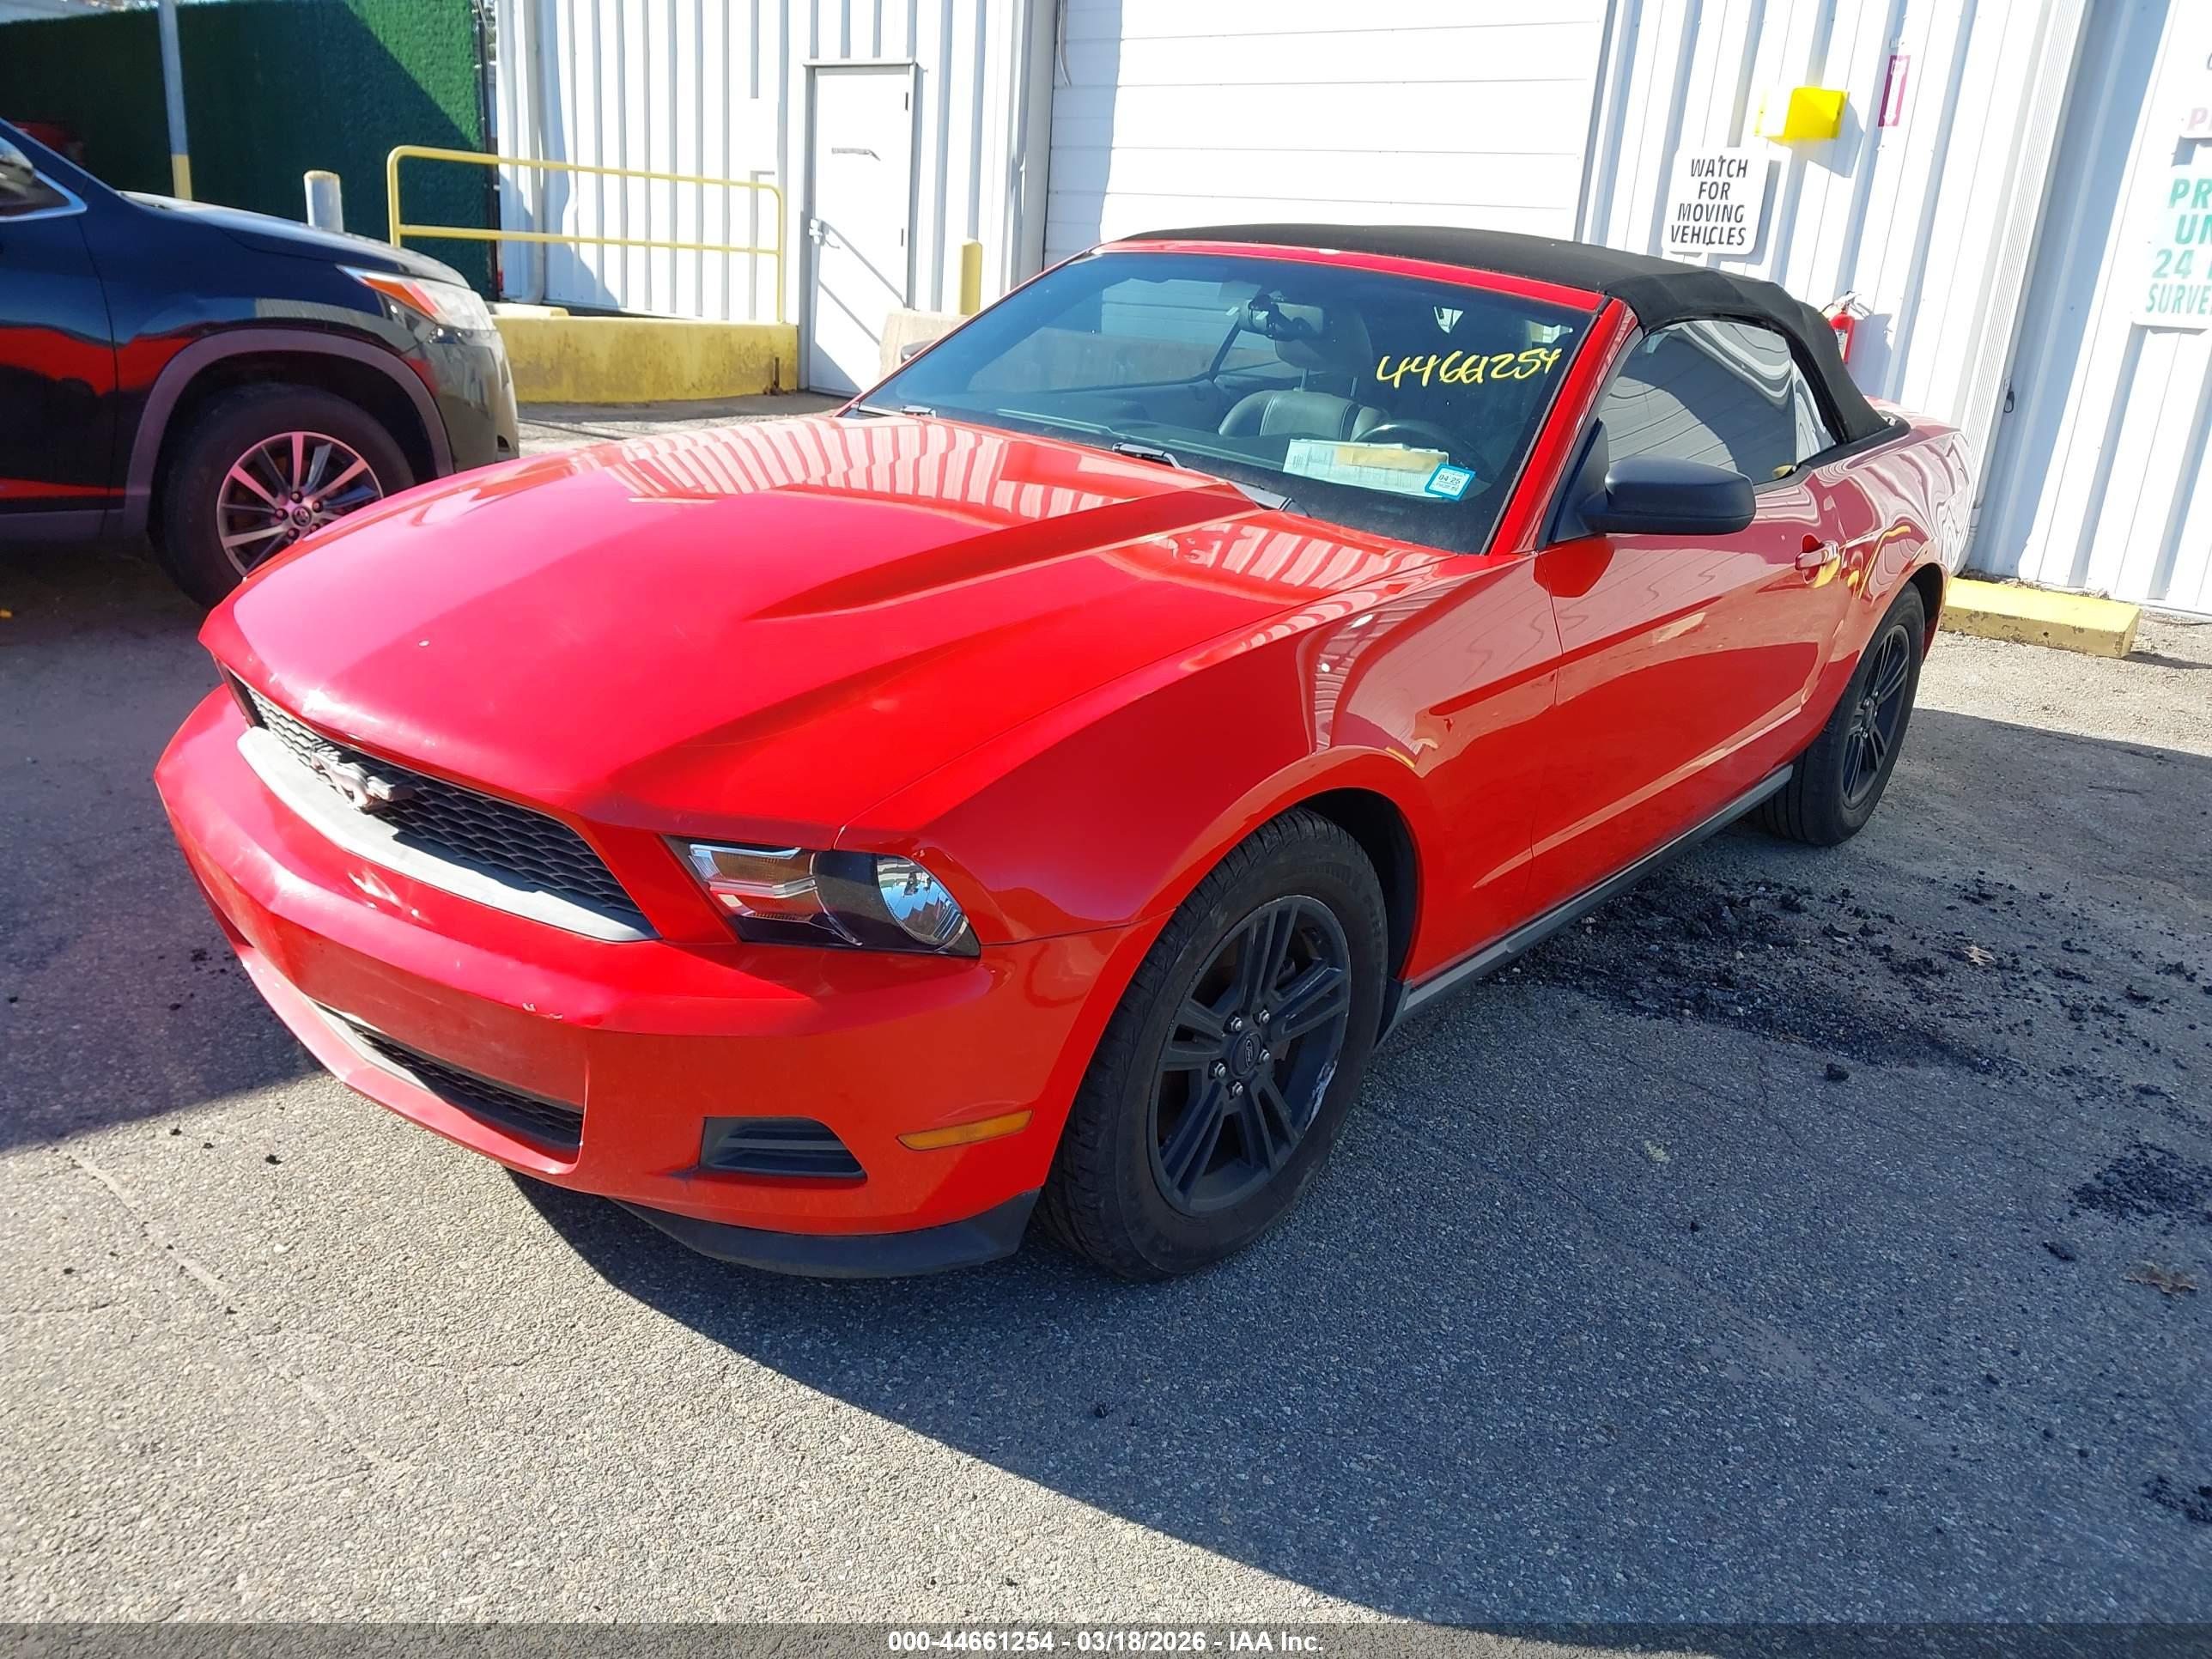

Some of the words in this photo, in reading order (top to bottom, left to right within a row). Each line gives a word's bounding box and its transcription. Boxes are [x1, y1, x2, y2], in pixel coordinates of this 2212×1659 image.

[2186, 107, 2212, 131] P
[1690, 157, 1748, 178] WATCH
[1698, 181, 1731, 200] FOR
[1677, 203, 1745, 223] MOVING
[1670, 225, 1747, 246] VEHICLES
[2152, 249, 2195, 279] 24
[2146, 283, 2212, 314] SURVE
